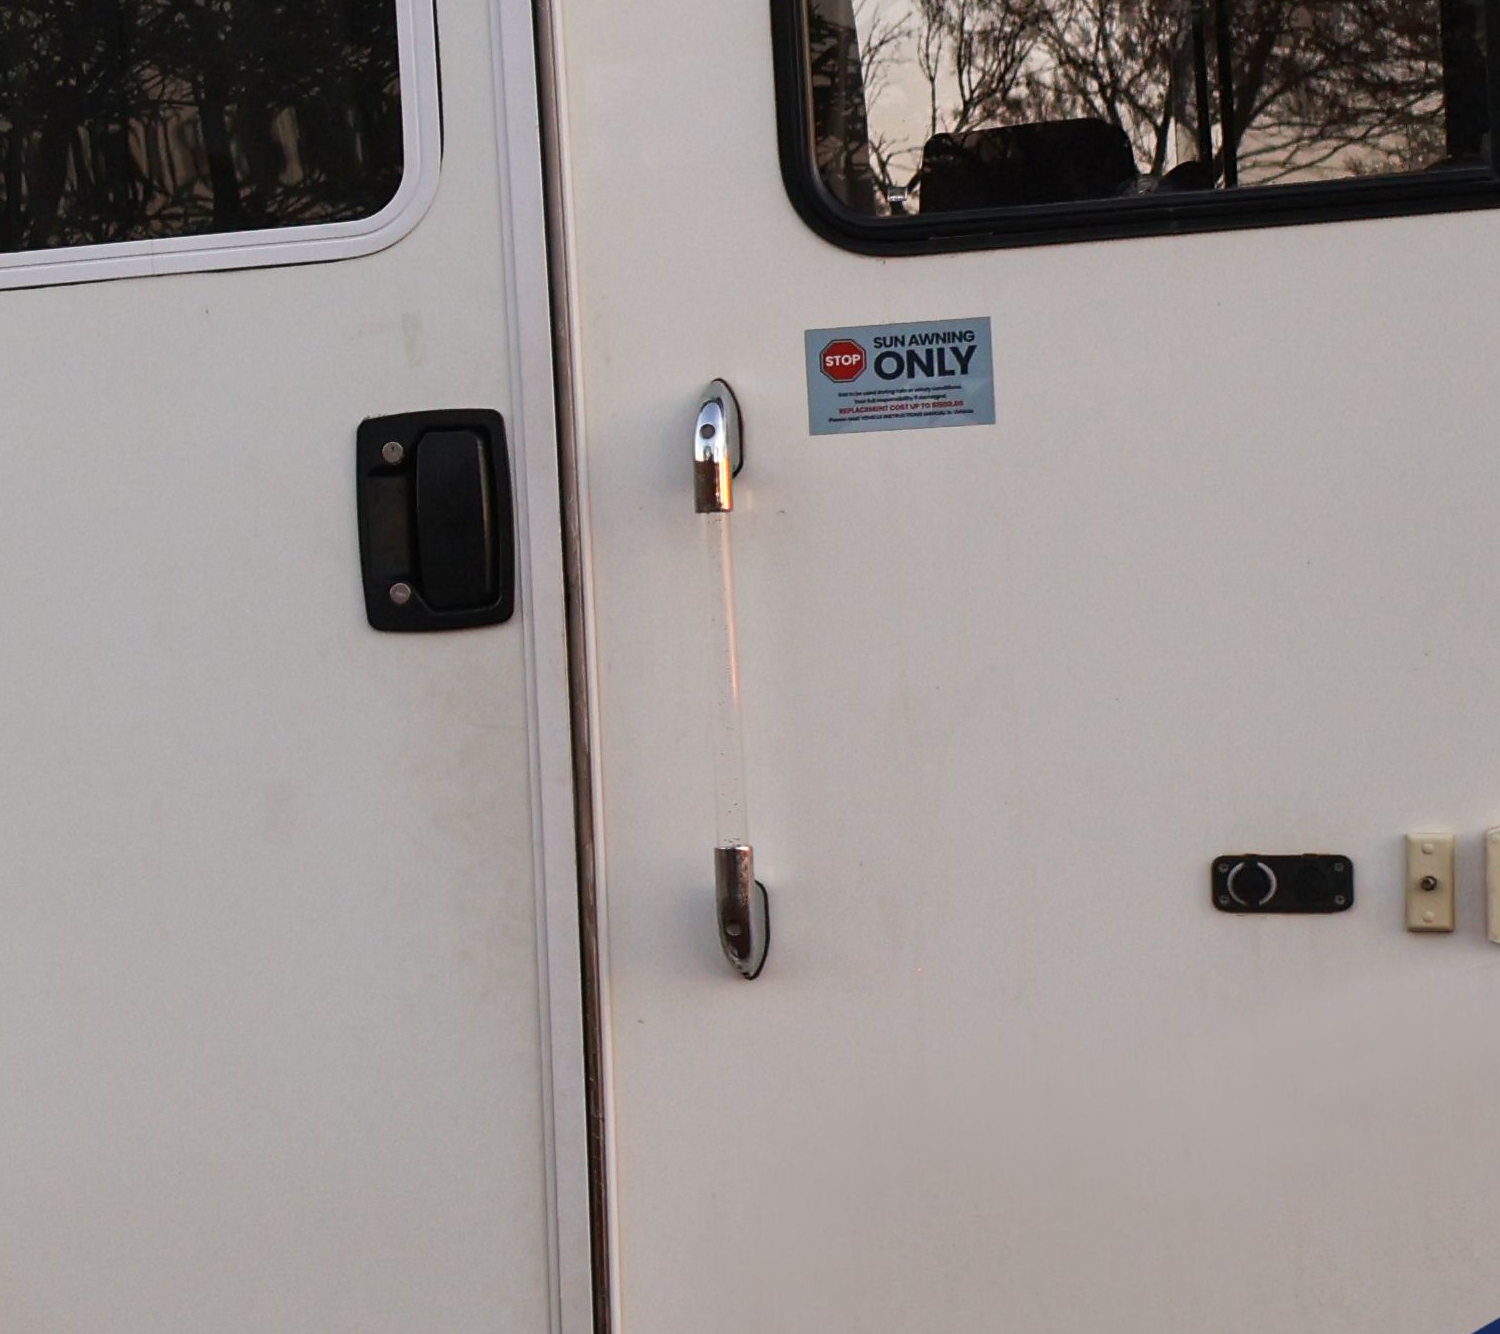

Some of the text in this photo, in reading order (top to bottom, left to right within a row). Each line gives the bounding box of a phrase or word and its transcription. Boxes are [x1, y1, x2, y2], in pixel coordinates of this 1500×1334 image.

[873, 330, 975, 349] SUN AWNING
[825, 354, 861, 367] STOP
[873, 345, 977, 380] ONLY
